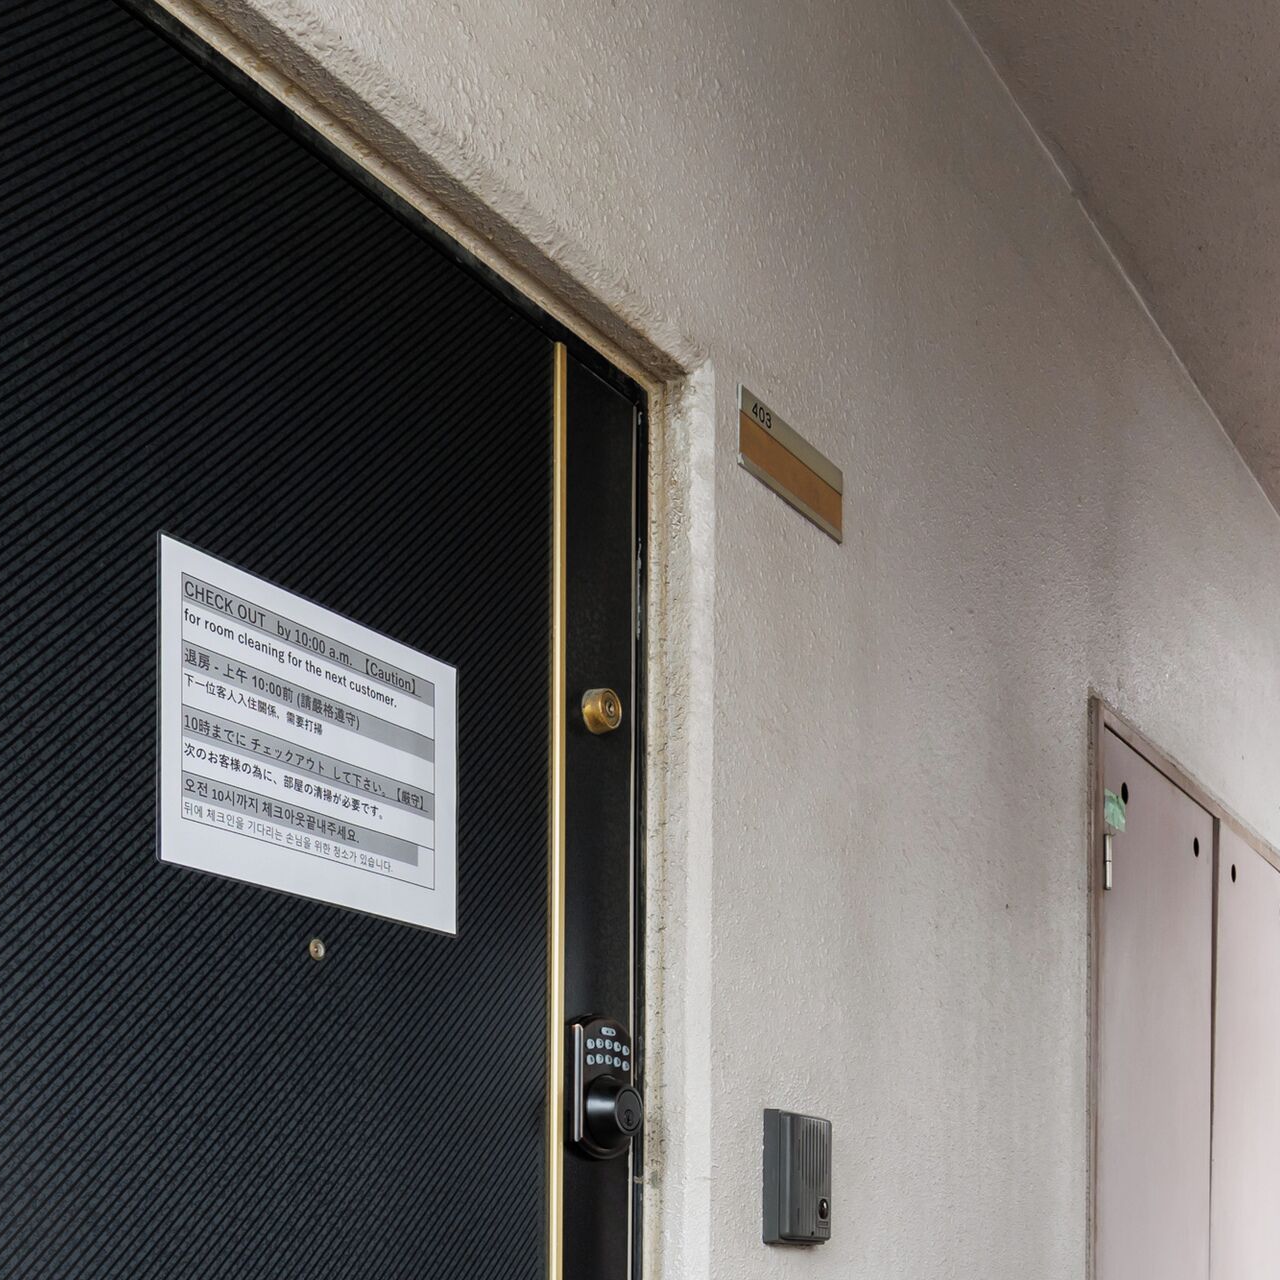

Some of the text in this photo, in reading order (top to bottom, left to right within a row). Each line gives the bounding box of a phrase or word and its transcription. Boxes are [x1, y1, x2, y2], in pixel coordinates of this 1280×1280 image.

[751, 402, 773, 430] 403
[184, 580, 234, 615] CHECK
[237, 604, 266, 628] OUT
[276, 620, 291, 641] by
[295, 629, 326, 655] 10:00
[329, 647, 353, 667] a.m.
[184, 608, 398, 708] for room cleaning for the next customer.
[184, 647, 211, 671] 退房
[223, 663, 248, 684] 上午
[252, 675, 294, 704] 10:00前
[184, 714, 246, 747] 10時までに
[250, 738, 325, 774] チェックアウト
[184, 778, 208, 798] 오전
[211, 788, 259, 814] 10시까지
[184, 801, 203, 819] 뒤에
[206, 808, 245, 831] 체크인을
[247, 820, 283, 842] 기다리는
[285, 832, 312, 850] 손님을
[313, 839, 331, 856] 위한
[359, 853, 394, 873] 있습니다.
